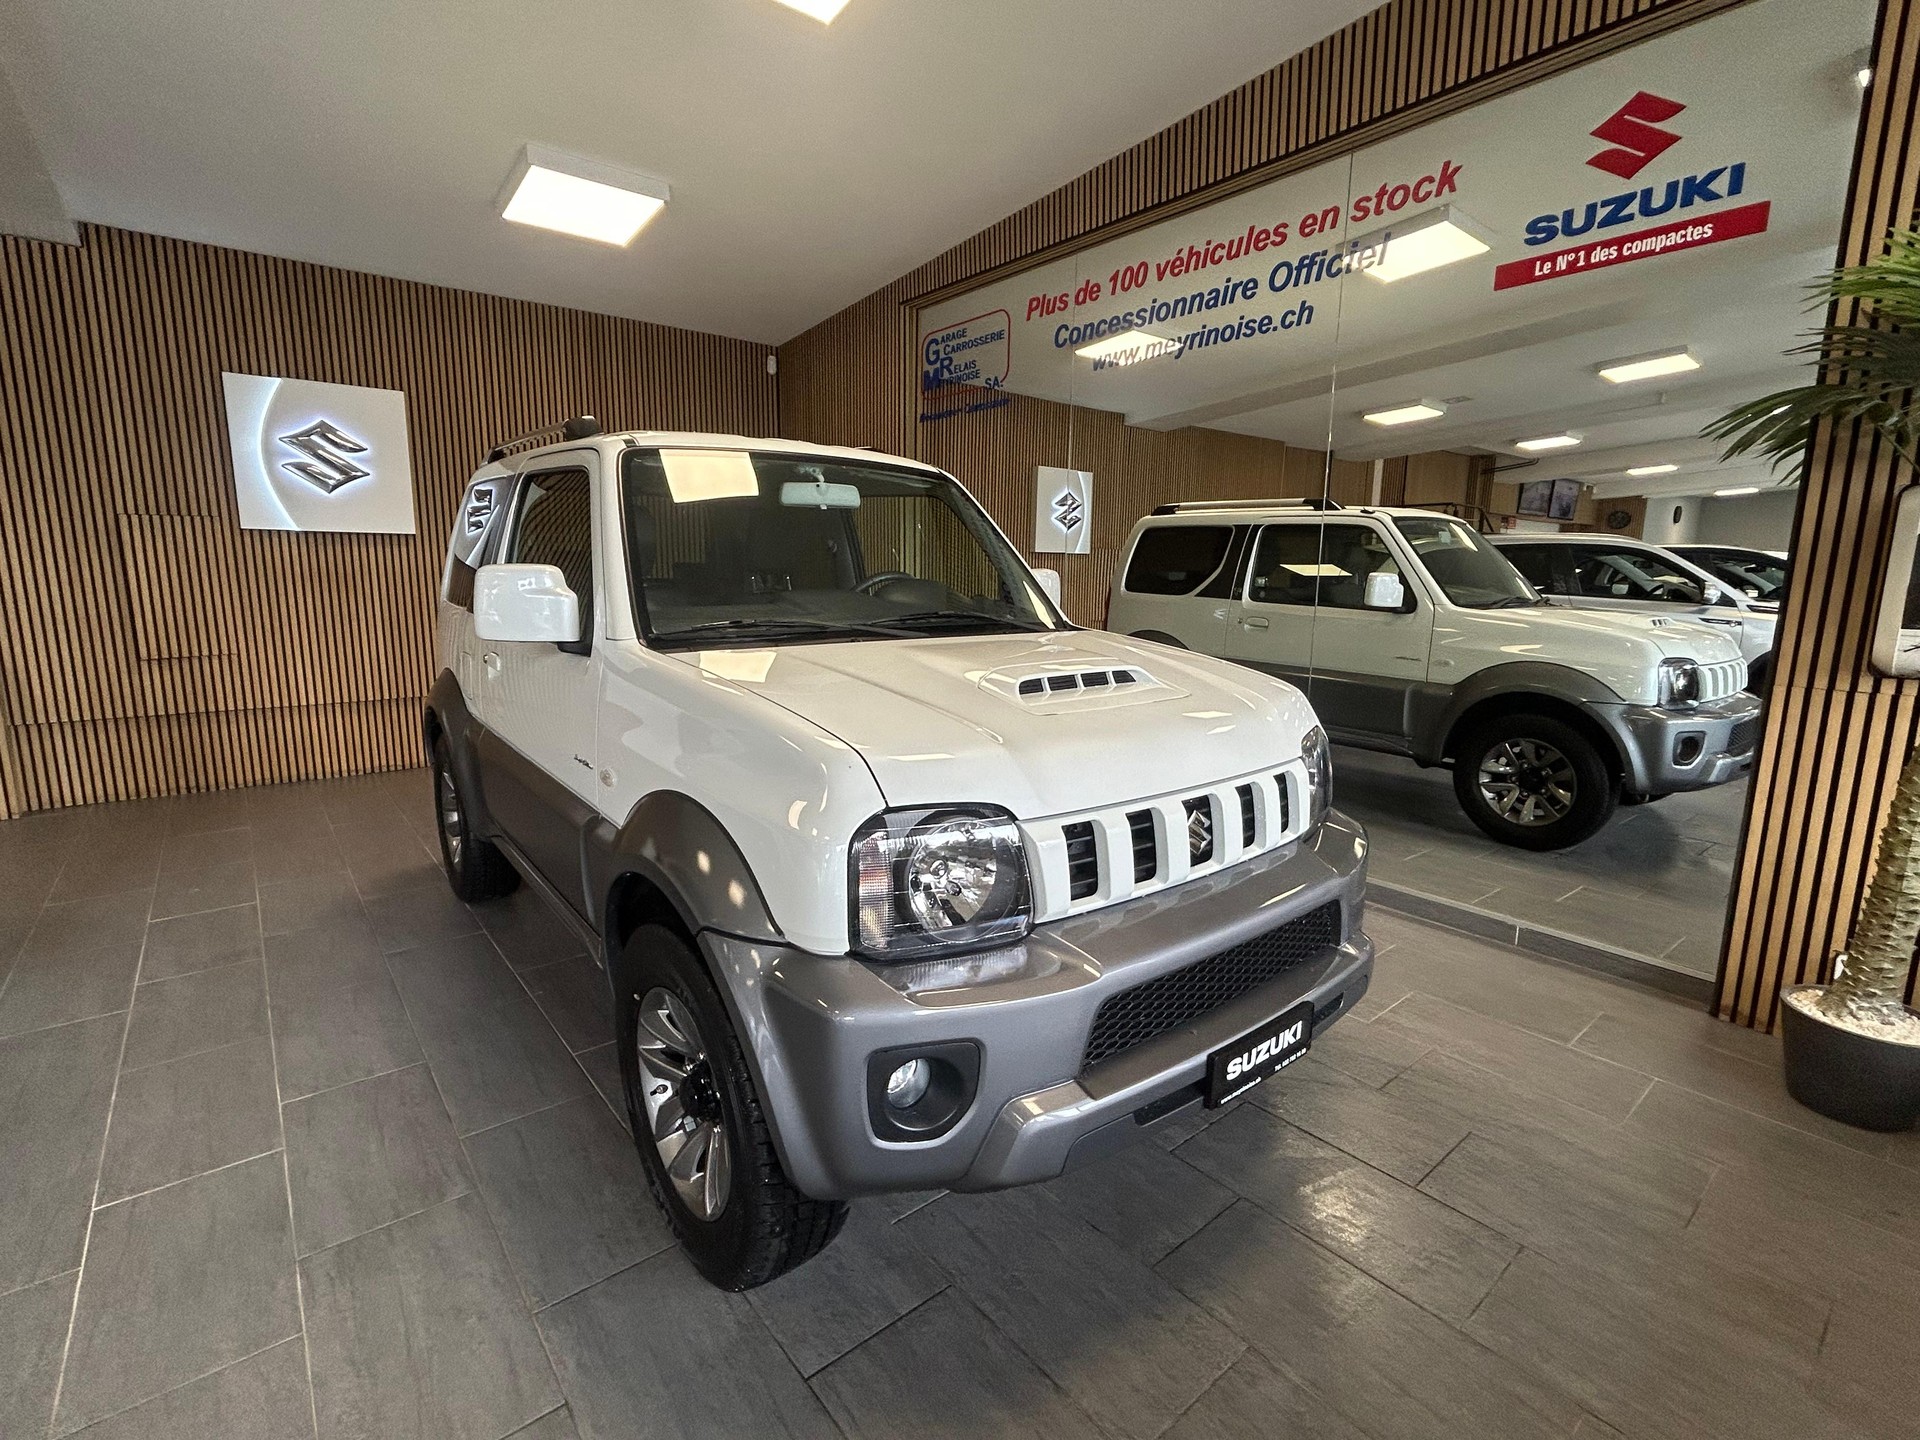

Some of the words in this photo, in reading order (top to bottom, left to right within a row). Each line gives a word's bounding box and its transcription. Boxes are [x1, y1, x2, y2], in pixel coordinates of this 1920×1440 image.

[1524, 162, 1746, 246] SUZUKI
[1026, 293, 1069, 321] Plus
[1074, 279, 1101, 306] de
[1109, 261, 1149, 296] 100
[1156, 222, 1289, 282] véhicules
[1298, 205, 1340, 238] en
[1350, 160, 1463, 223] stock
[1534, 260, 1552, 277] Le
[1590, 245, 1618, 265] des
[1622, 222, 1713, 256] compactes
[1054, 276, 1258, 349] Concessionnaire
[1268, 232, 1392, 292] Officiel
[925, 328, 968, 366] GARAGE
[943, 329, 1005, 355] CARROSSERIE
[1093, 300, 1314, 371] www.meyrinoise.ch
[940, 356, 977, 378] RELAIS
[1226, 1020, 1302, 1081] SUZUKI
